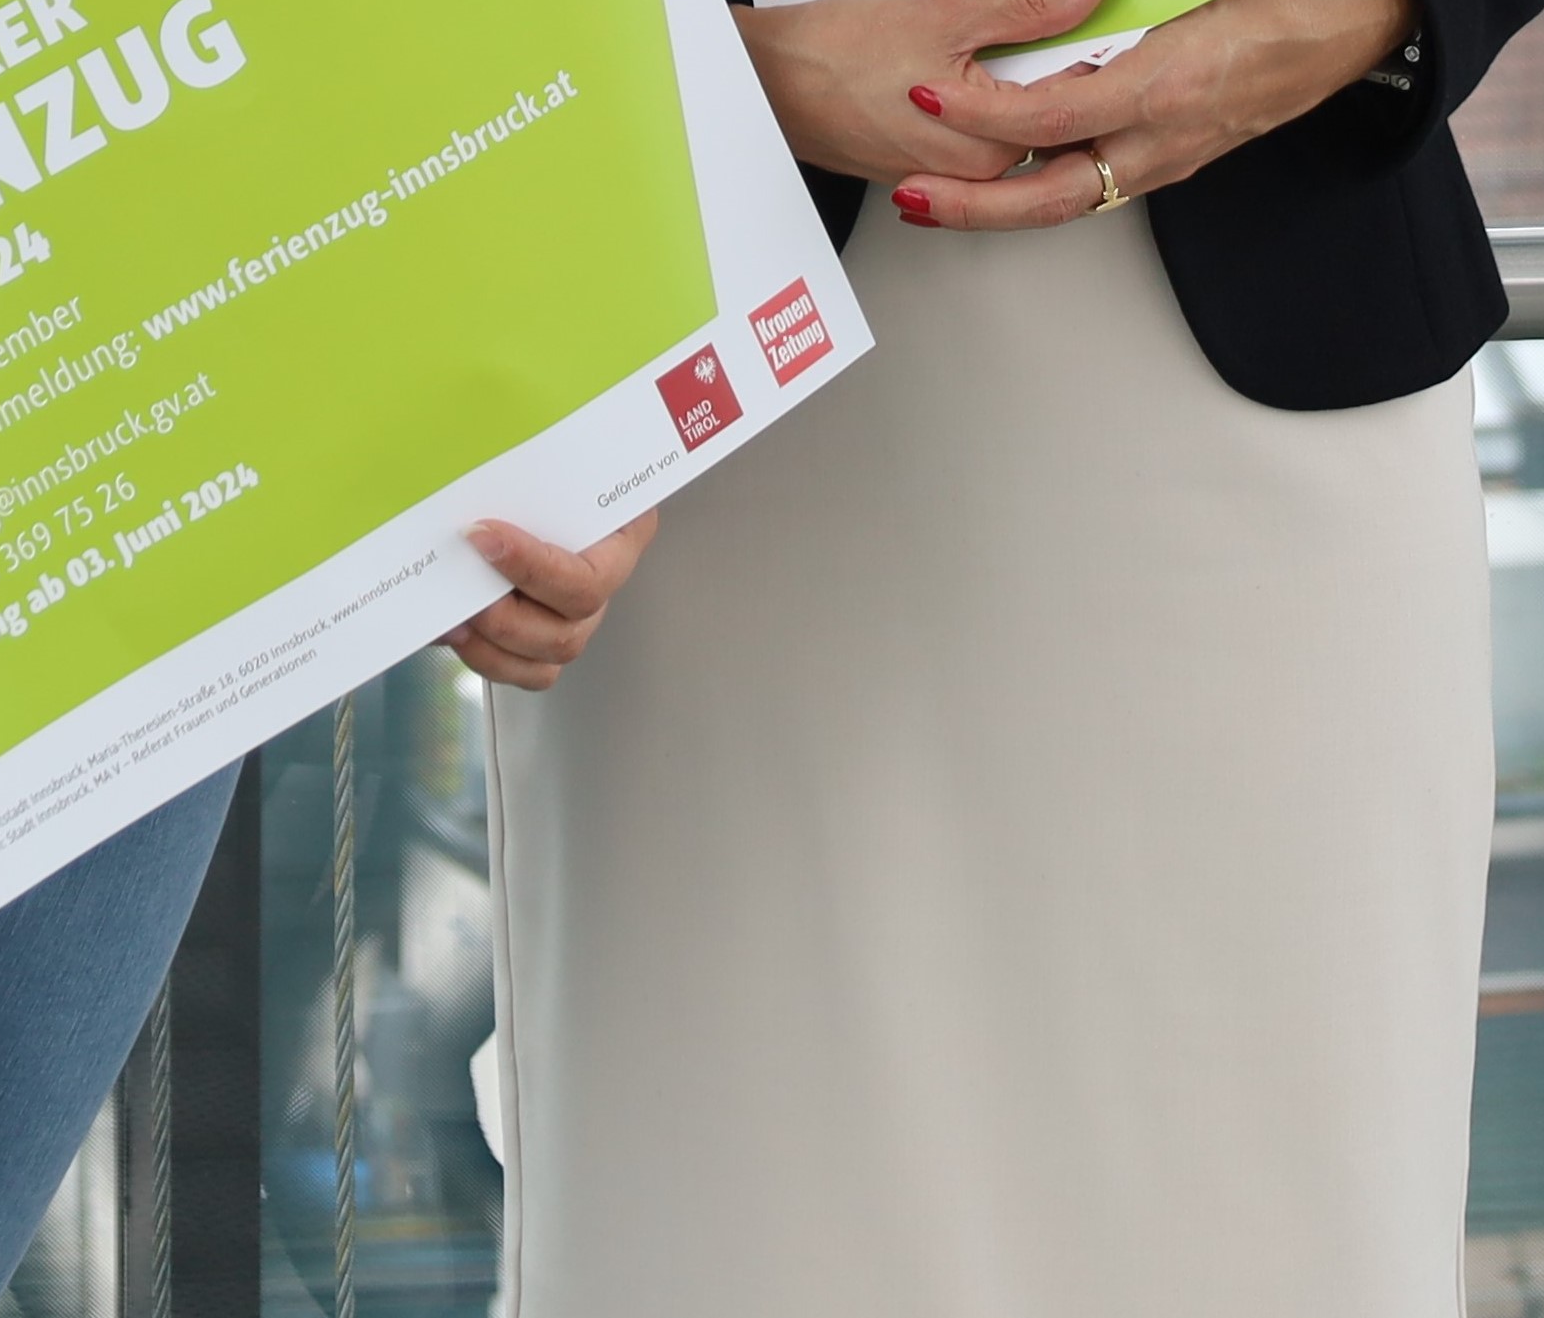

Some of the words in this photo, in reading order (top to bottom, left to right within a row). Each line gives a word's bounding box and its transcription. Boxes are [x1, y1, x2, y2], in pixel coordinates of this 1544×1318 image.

[142, 70, 578, 340] www.ferienzug-innsbruck.at
[756, 294, 818, 345] Kronen
[763, 317, 831, 371] Zeitung
[679, 400, 714, 434] LAND
[683, 412, 720, 442] TIROL
[594, 461, 658, 509] Gefördert
[654, 448, 681, 471] von
[0, 522, 51, 572] 369
[54, 496, 94, 535] 75
[96, 473, 136, 513] 26
[27, 574, 66, 613] ab
[66, 548, 115, 586] 03.
[114, 501, 182, 568] Juni
[181, 463, 258, 521] 2024
[235, 650, 271, 679] 6020
[329, 548, 441, 625] www.innsbruck.gv.at
[91, 767, 113, 788] MA
[130, 729, 175, 764] Referat
[172, 705, 215, 739] Frauen
[213, 689, 241, 714] und
[237, 645, 319, 699] Generationen
